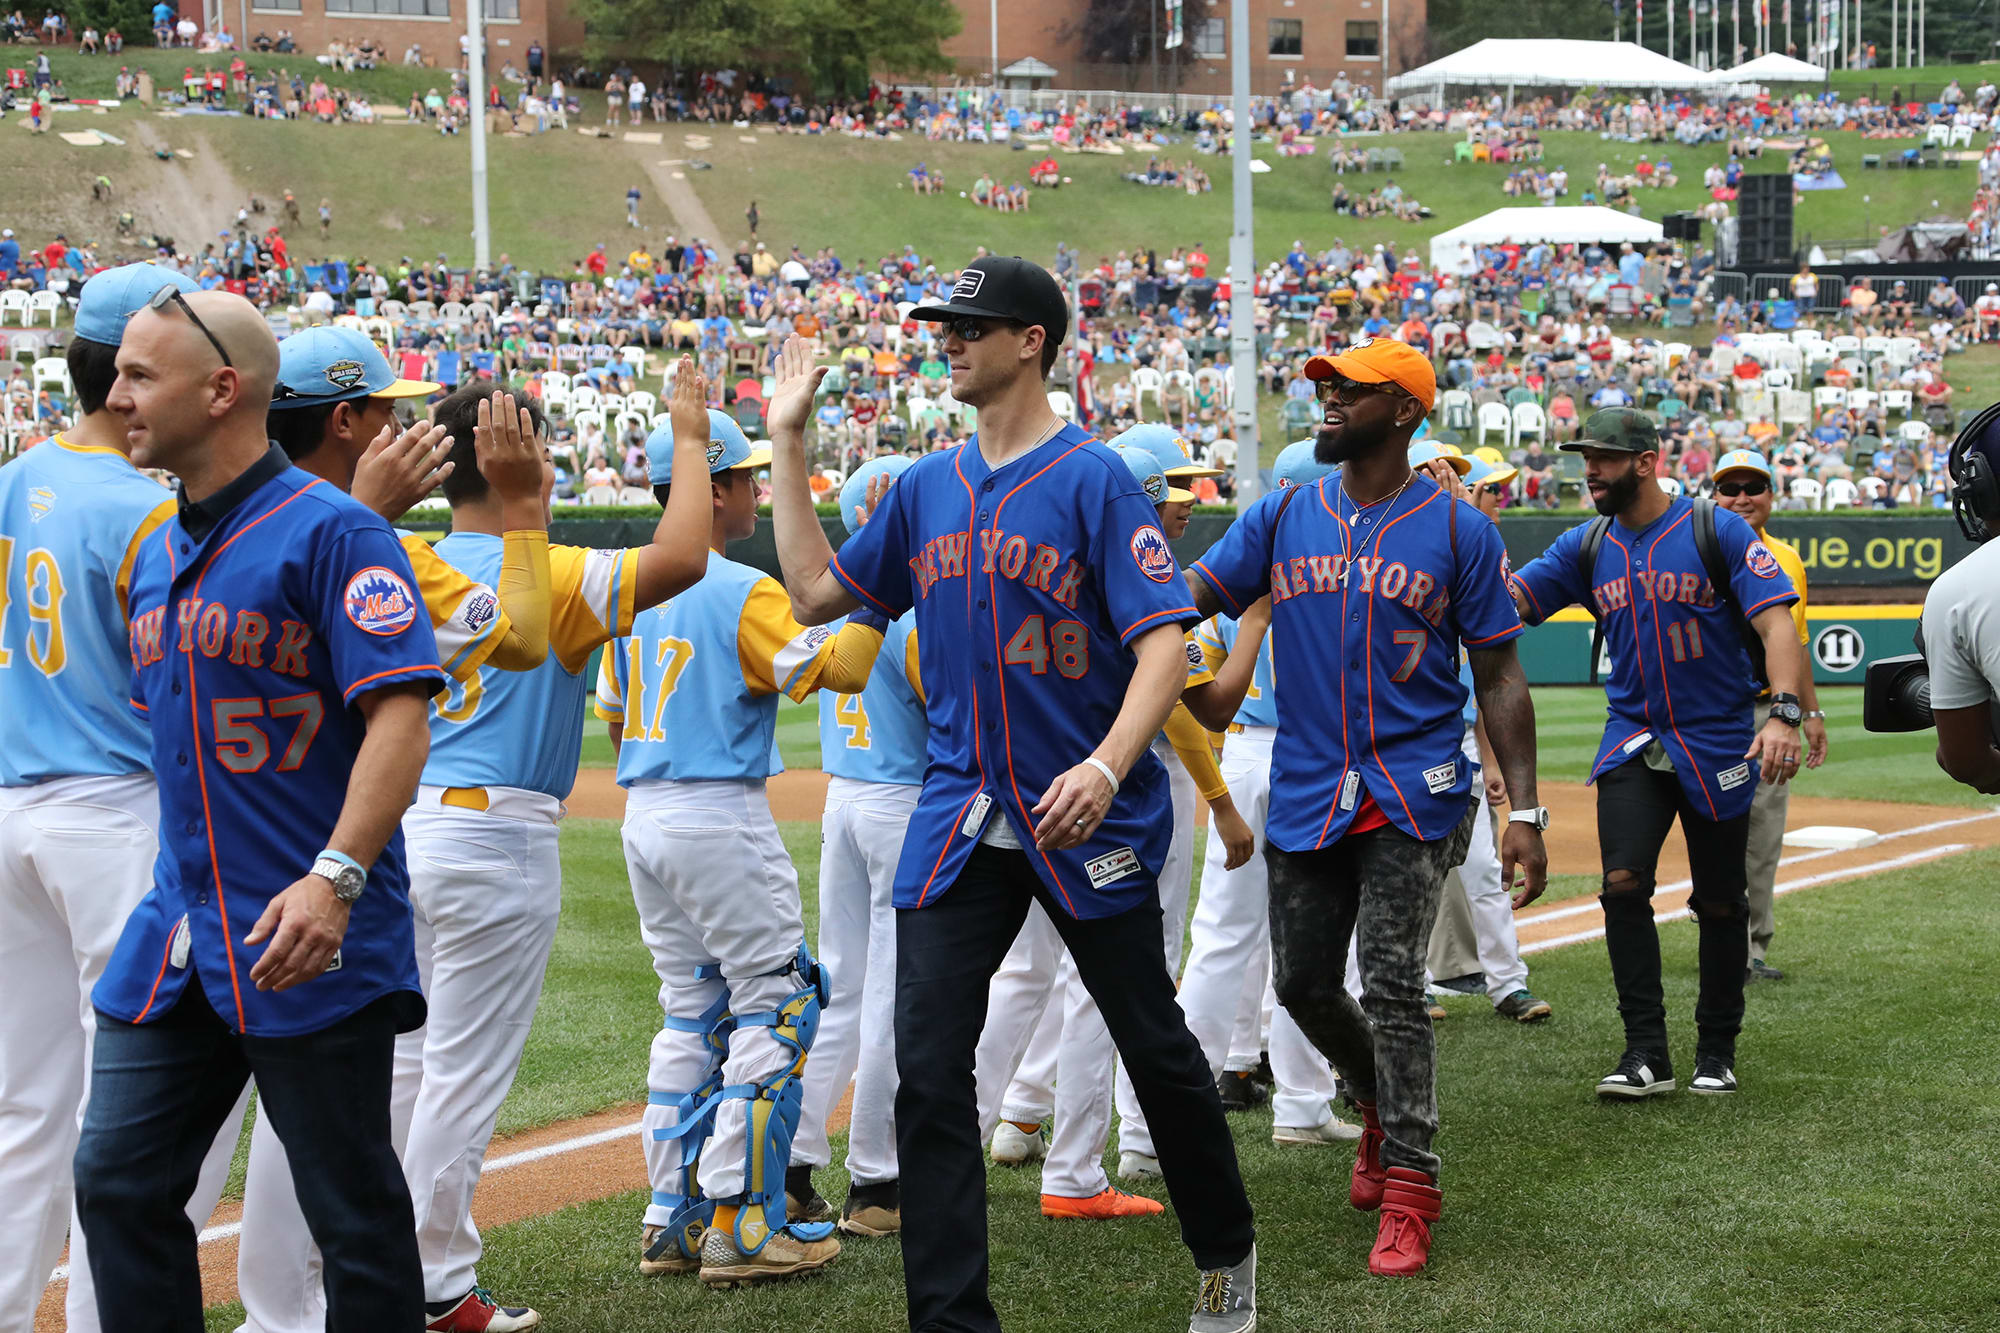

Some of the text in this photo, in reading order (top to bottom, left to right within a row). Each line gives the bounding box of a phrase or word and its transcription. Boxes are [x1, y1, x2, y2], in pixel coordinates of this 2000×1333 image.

[909, 529, 1085, 609] NEW YORK
[1142, 547, 1169, 567] Mets
[359, 591, 406, 621] Mets
[1270, 555, 1450, 627] NEW YORK
[1592, 576, 1629, 617] EW
[178, 598, 313, 677] YORK
[1004, 614, 1089, 680] 48
[1390, 629, 1427, 682] 7
[1667, 617, 1704, 663] 11
[1822, 632, 1858, 665] 11
[622, 635, 695, 742] 17
[211, 691, 325, 774] 57
[834, 692, 872, 750] 4
